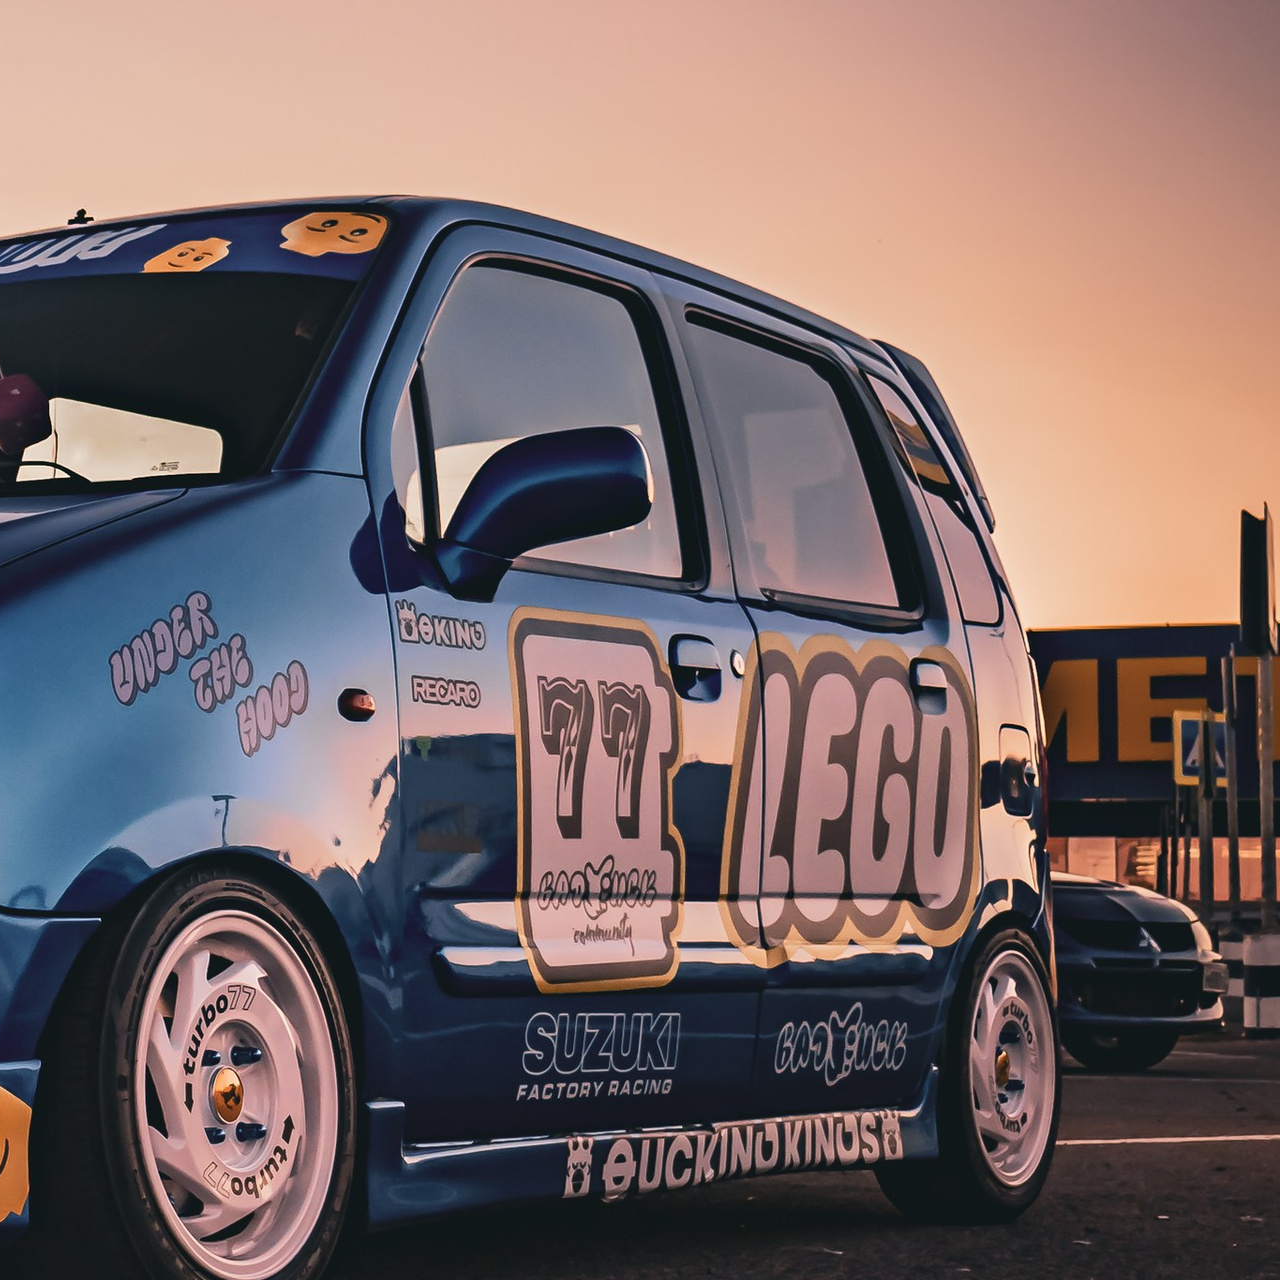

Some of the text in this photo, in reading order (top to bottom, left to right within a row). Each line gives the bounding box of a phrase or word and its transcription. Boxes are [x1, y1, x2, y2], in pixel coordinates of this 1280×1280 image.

[108, 590, 219, 706] UNDER
[189, 632, 254, 714] THE
[411, 674, 482, 709] RECARO
[235, 659, 309, 758] HOOD
[536, 674, 651, 840] 77
[734, 670, 971, 929] LEGO
[521, 1011, 682, 1076] SUZUKI
[516, 1078, 673, 1102] FACTORY RACING
